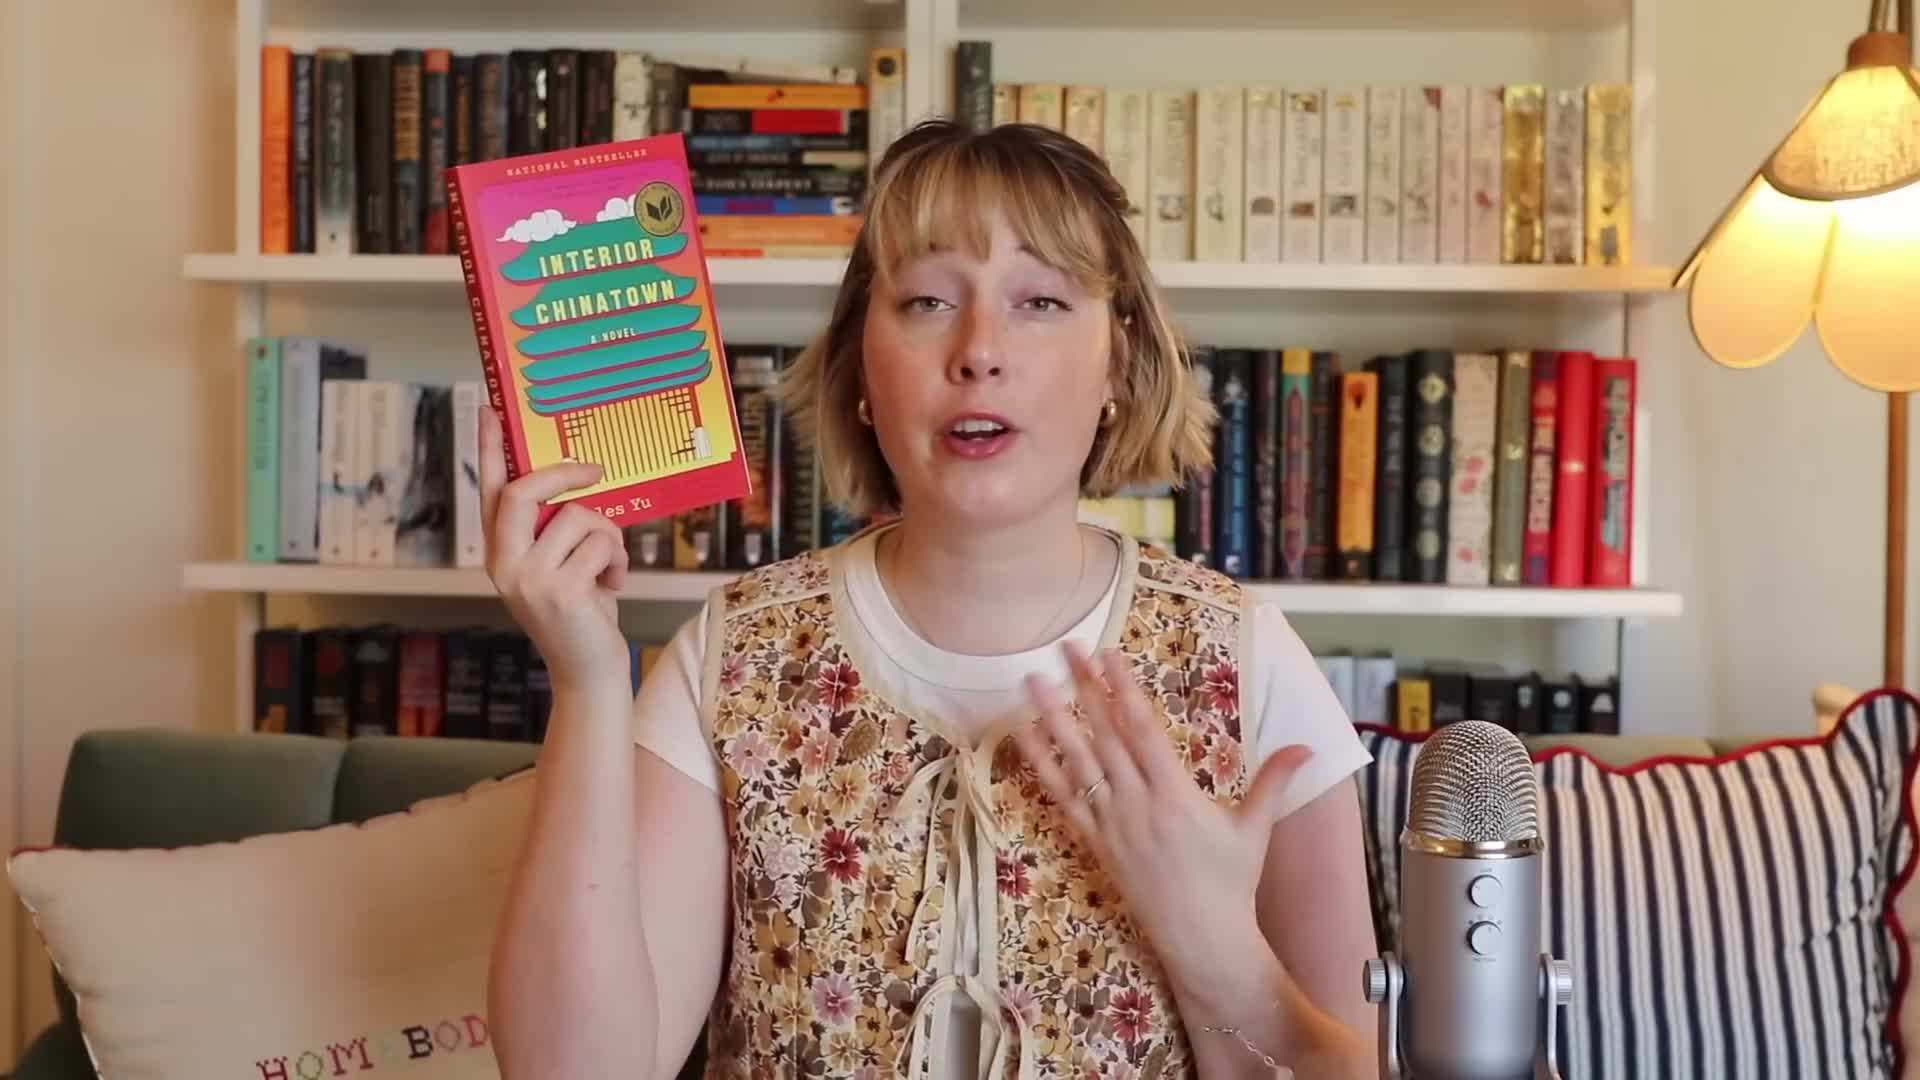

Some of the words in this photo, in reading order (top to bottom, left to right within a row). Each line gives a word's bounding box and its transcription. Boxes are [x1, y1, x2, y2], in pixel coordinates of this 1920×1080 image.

[506, 161, 568, 177] NATIONAL
[574, 148, 648, 166] BESTSELLER
[447, 181, 475, 285] INTERIOR
[539, 238, 654, 278] INTERIOR
[535, 279, 676, 325] CHINATOWN
[590, 334, 597, 344] A
[602, 327, 637, 342] NOVEL
[629, 497, 652, 511] Yu
